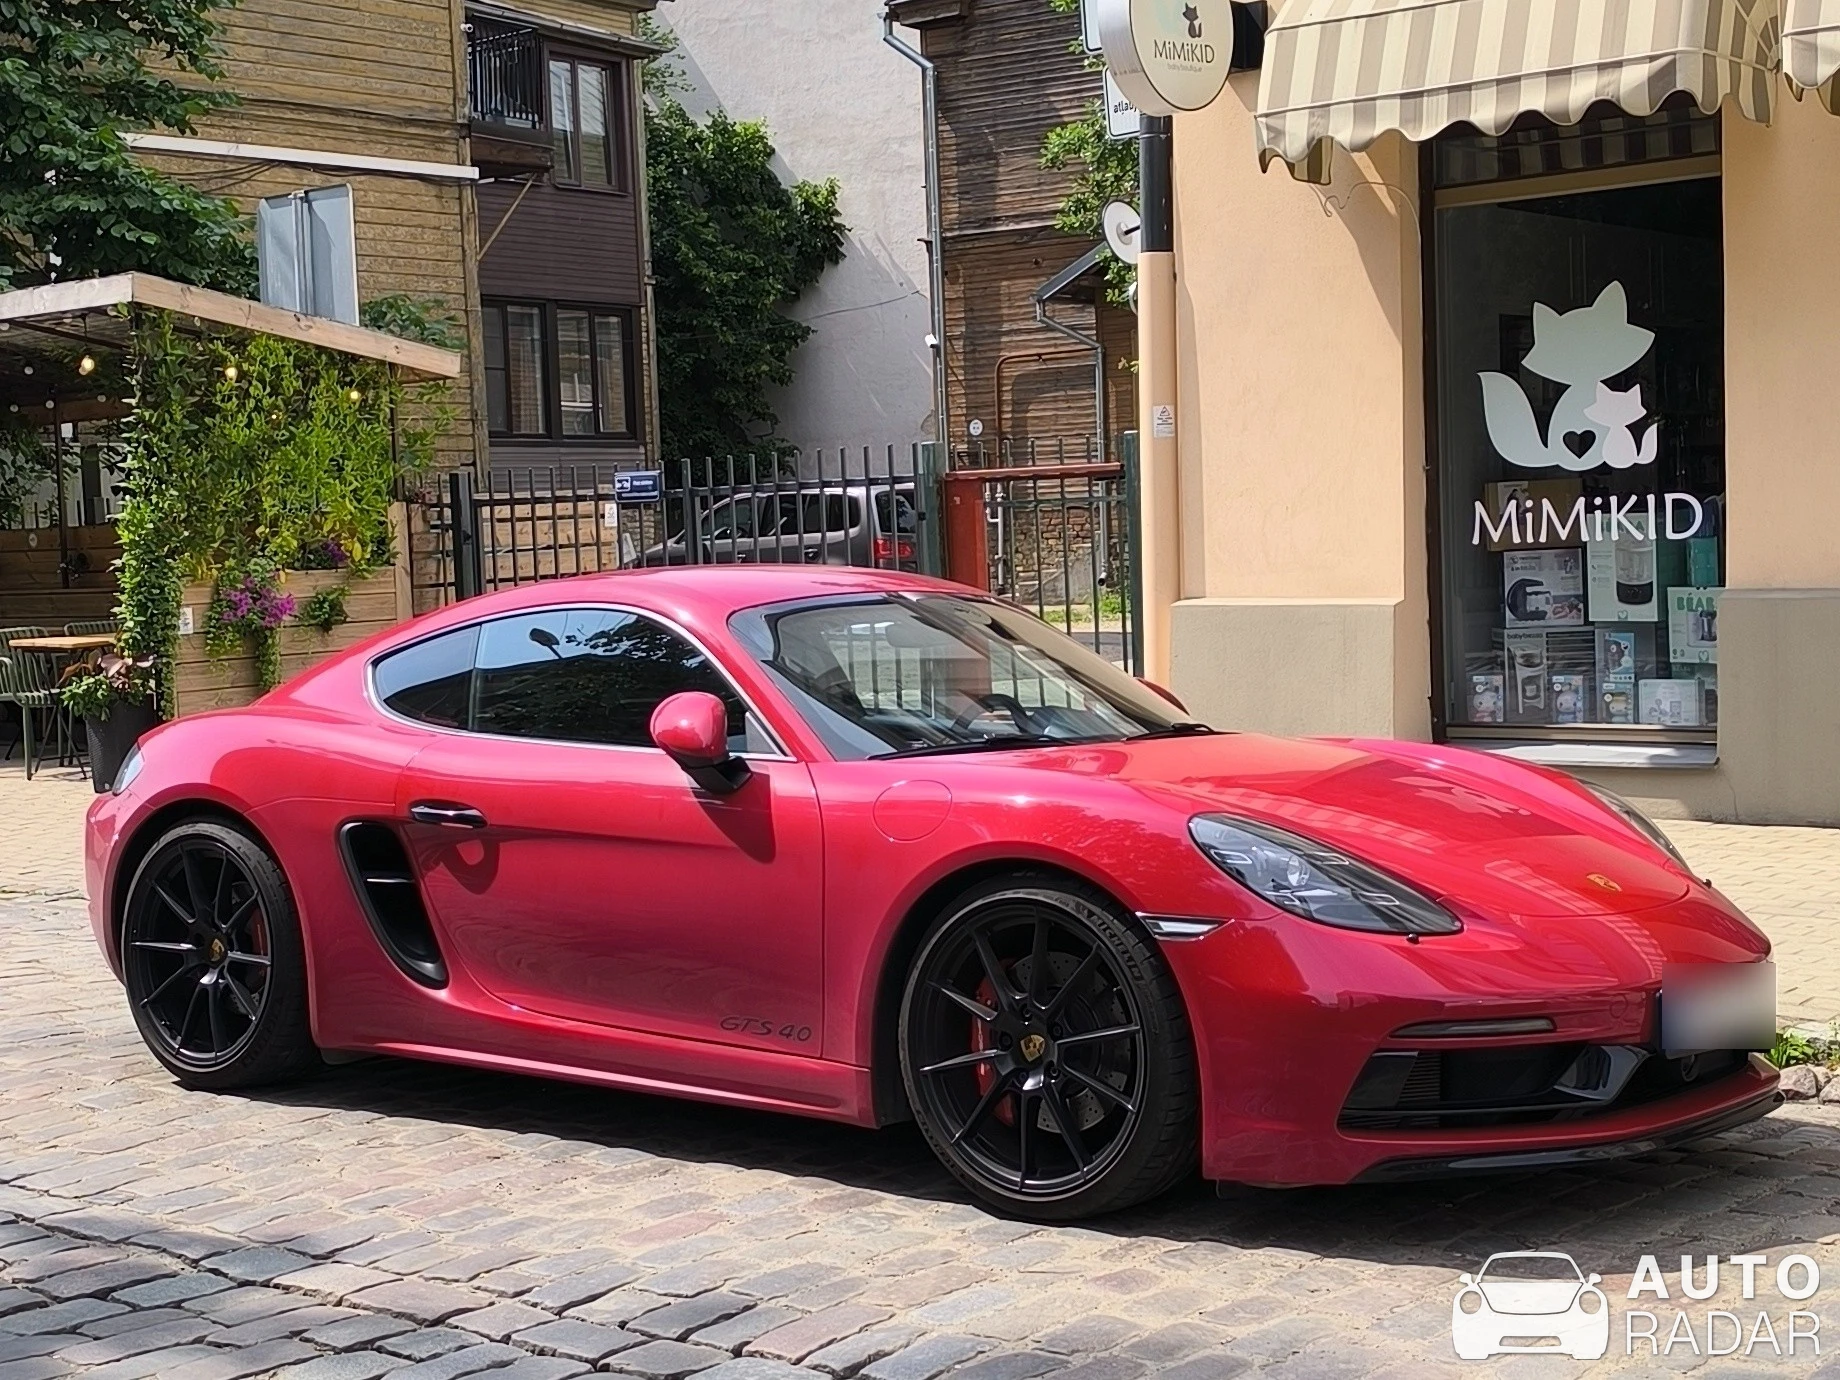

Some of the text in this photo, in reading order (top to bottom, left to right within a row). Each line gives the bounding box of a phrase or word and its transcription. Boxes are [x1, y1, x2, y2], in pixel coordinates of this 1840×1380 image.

[1154, 39, 1215, 63] MiMiKID
[1472, 492, 1703, 545] MiMiKID
[720, 1016, 773, 1036] GTS
